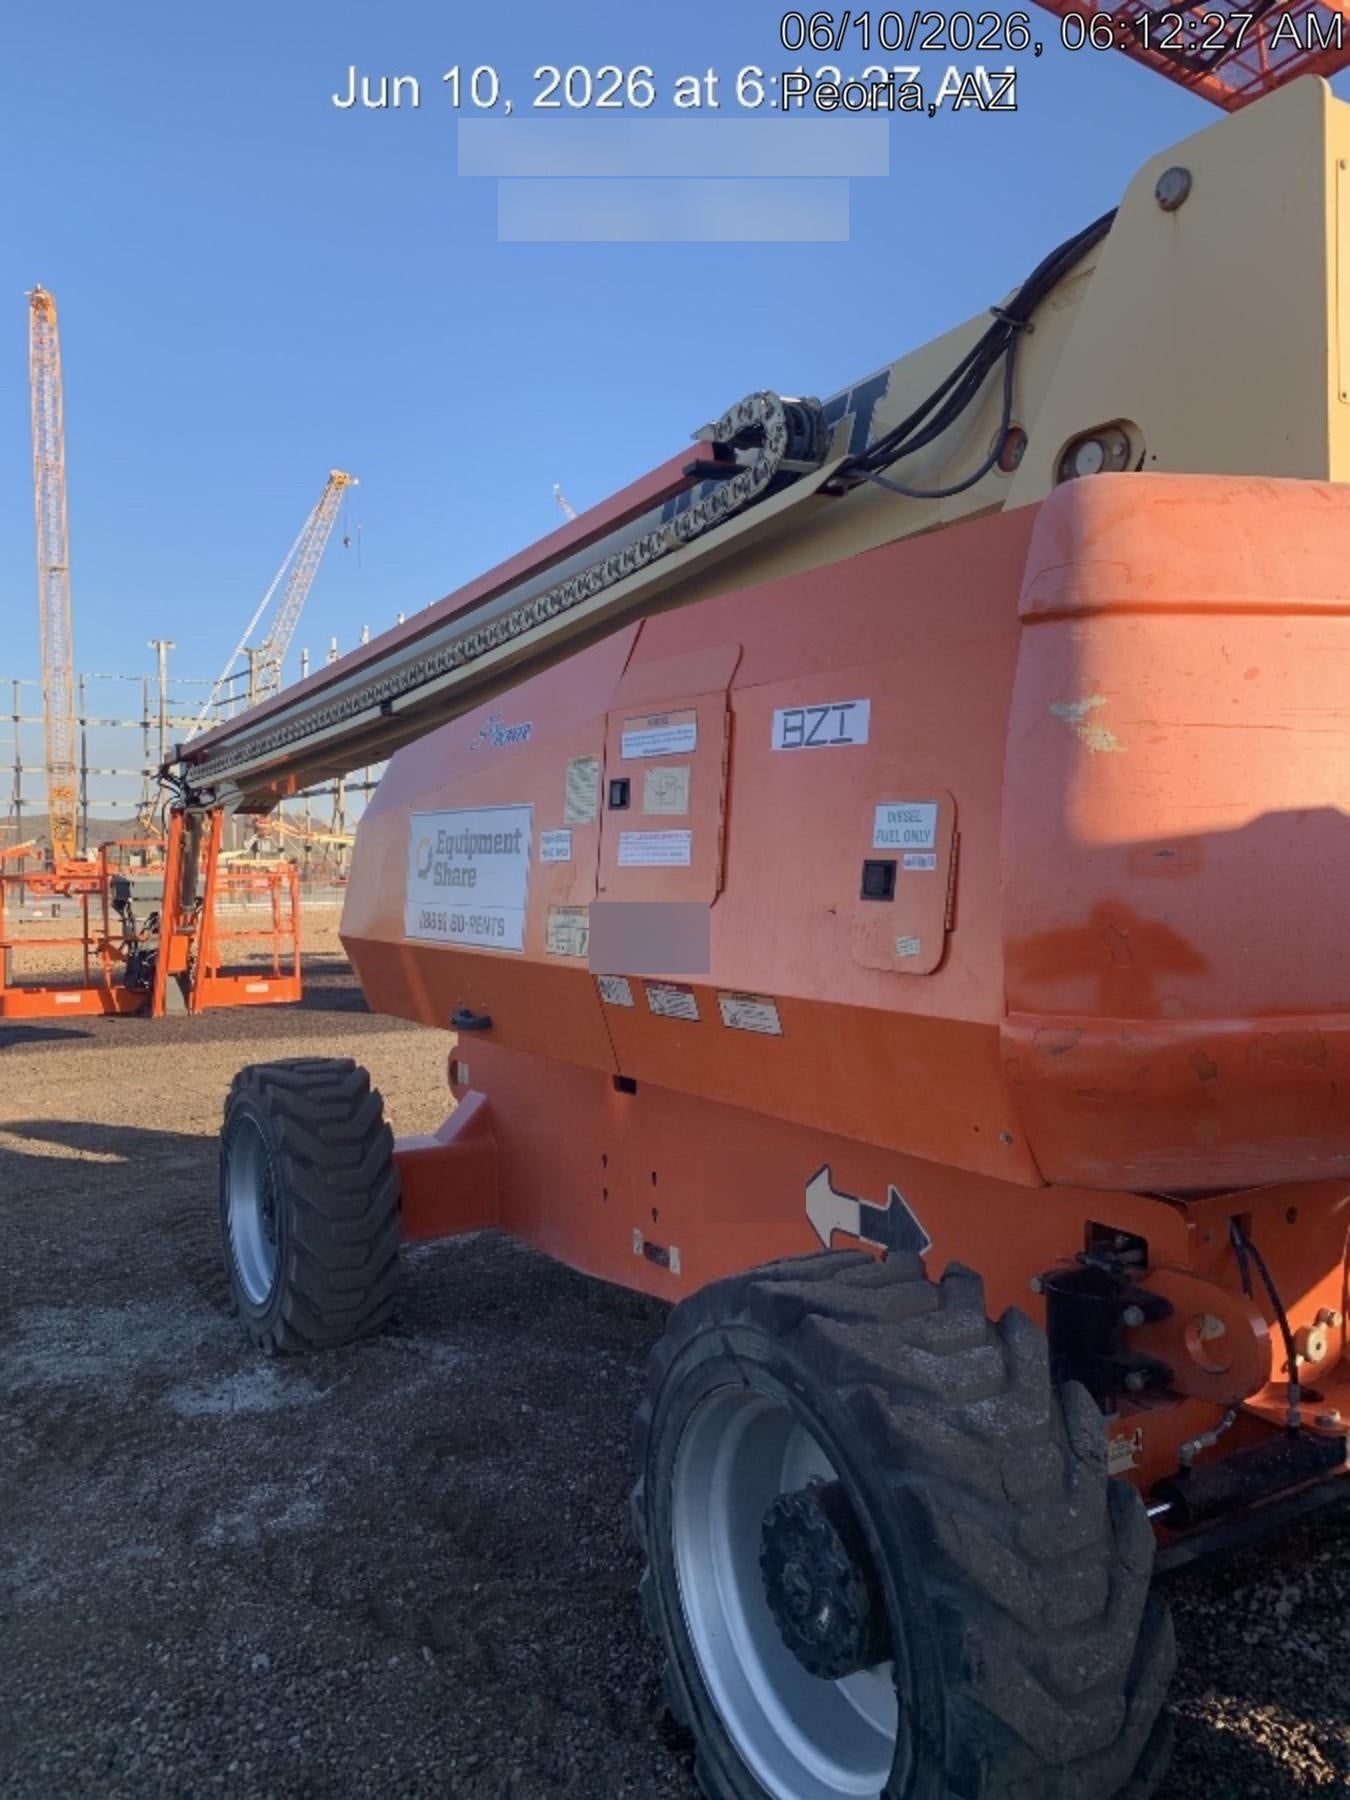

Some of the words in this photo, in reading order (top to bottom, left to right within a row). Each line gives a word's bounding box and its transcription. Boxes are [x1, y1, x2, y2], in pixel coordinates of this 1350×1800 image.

[887, 809, 923, 823] DIESEL
[435, 828, 523, 860] Equipment
[876, 829, 900, 843] FUEL
[903, 829, 931, 843] ONLY
[433, 861, 477, 888] Share
